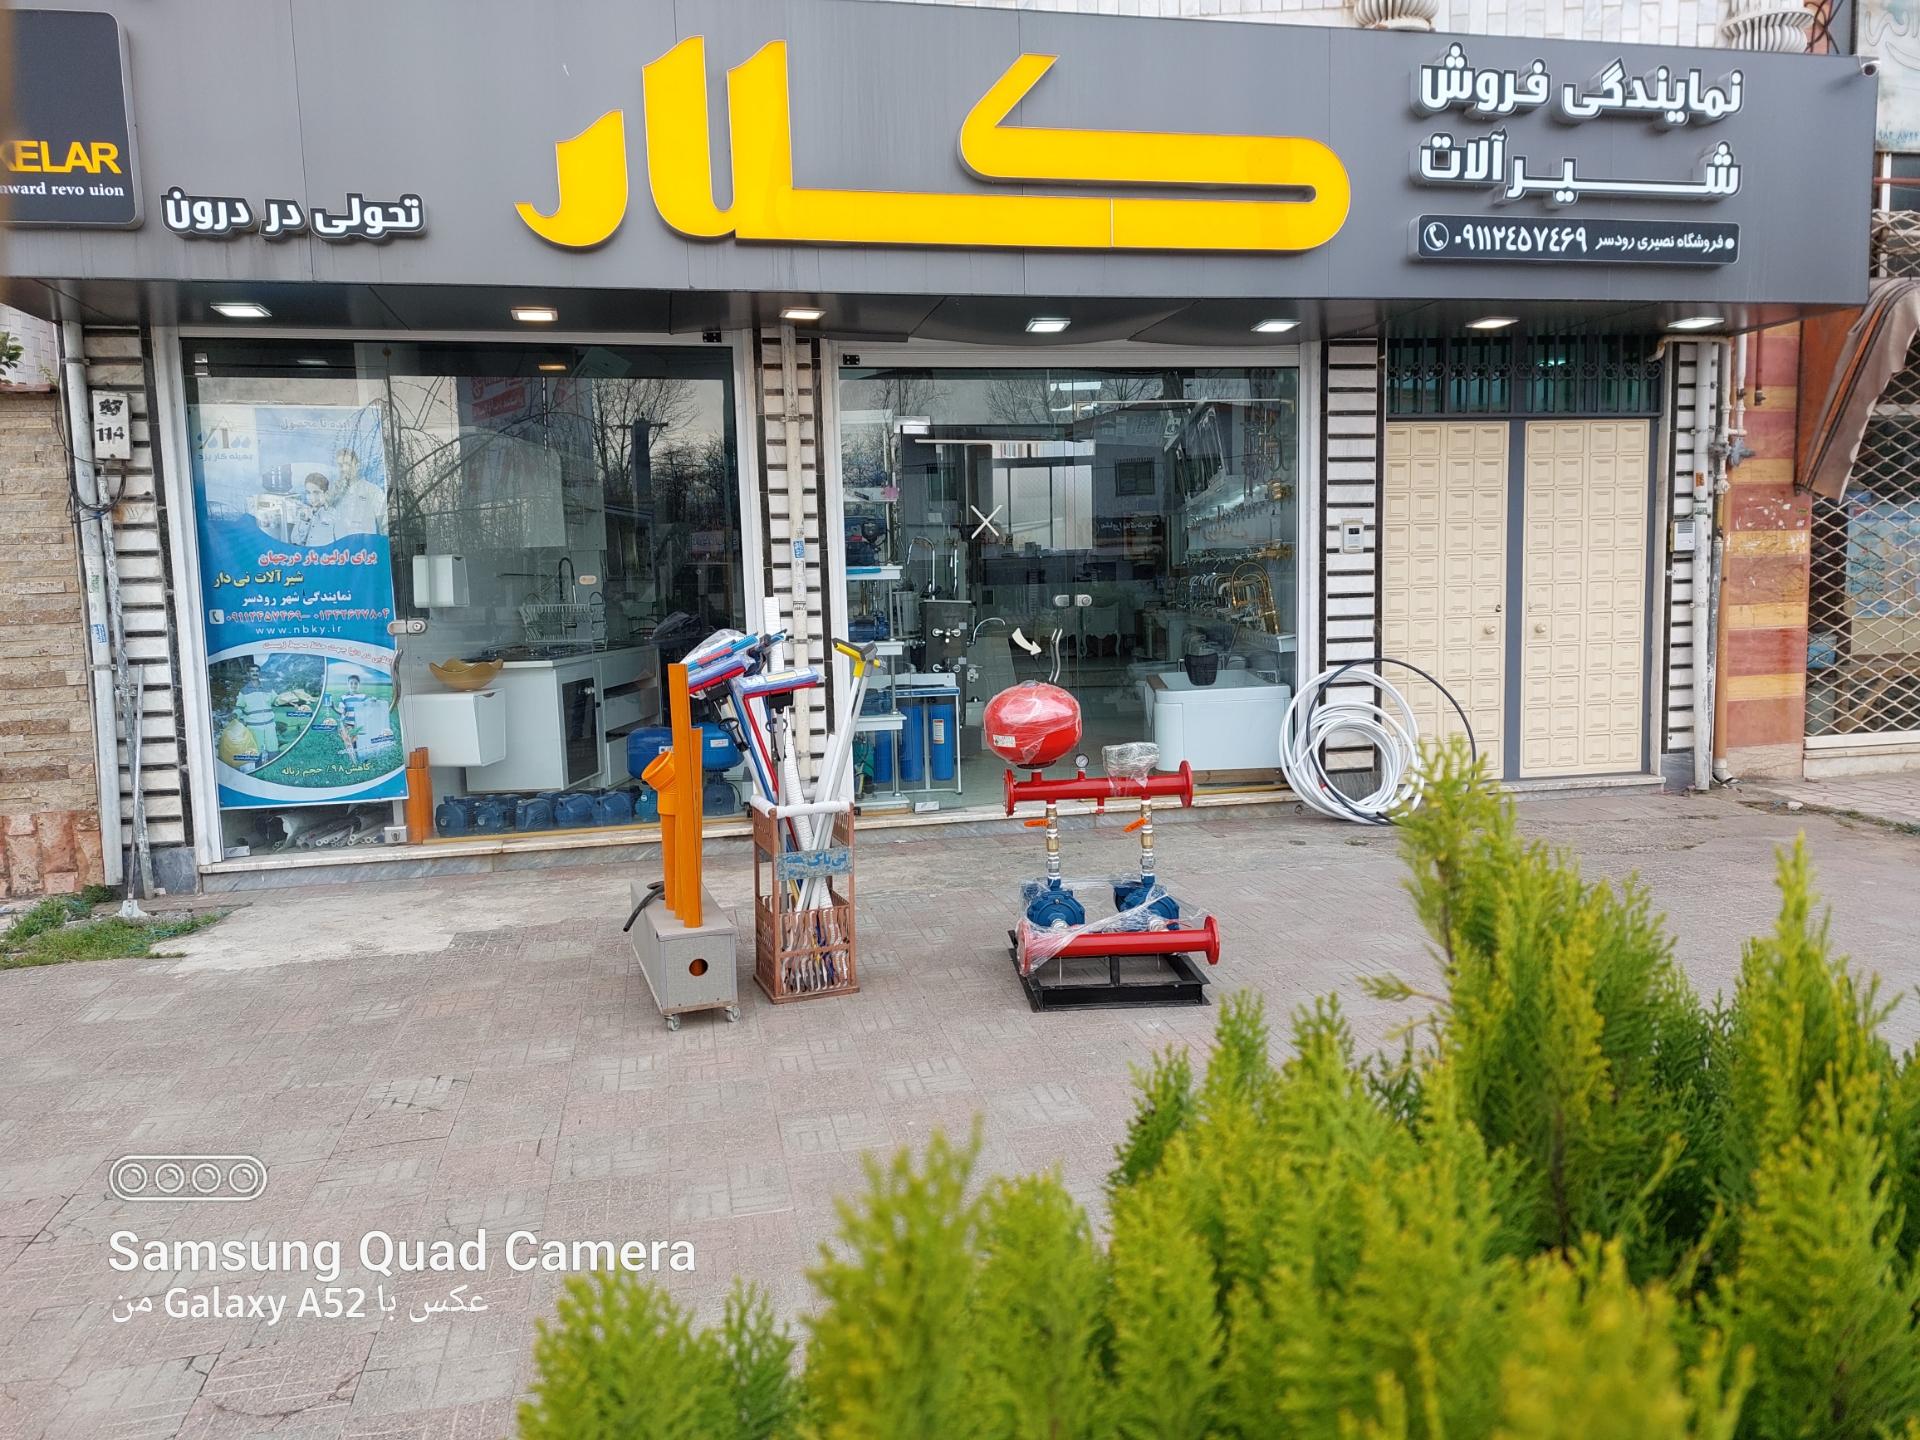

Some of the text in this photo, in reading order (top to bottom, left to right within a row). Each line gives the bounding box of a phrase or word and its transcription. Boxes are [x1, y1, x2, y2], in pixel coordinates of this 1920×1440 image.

[1421, 43, 1742, 123] نمایندگی فروش
[1421, 131, 1740, 201] شیر آلات
[166, 190, 421, 236] تحولی در درون
[1595, 234, 1635, 250] رودسر
[1637, 235, 1674, 251] نصیری
[1677, 233, 1723, 254] فروشگاه
[303, 549, 319, 566] بار
[320, 549, 349, 566] اولین
[352, 549, 377, 566] برای
[254, 569, 282, 584] آلات
[242, 589, 352, 607] نمایندگی شهر رودسر
[255, 624, 342, 635] www.nbky.ir
[303, 767, 322, 777] حجم
